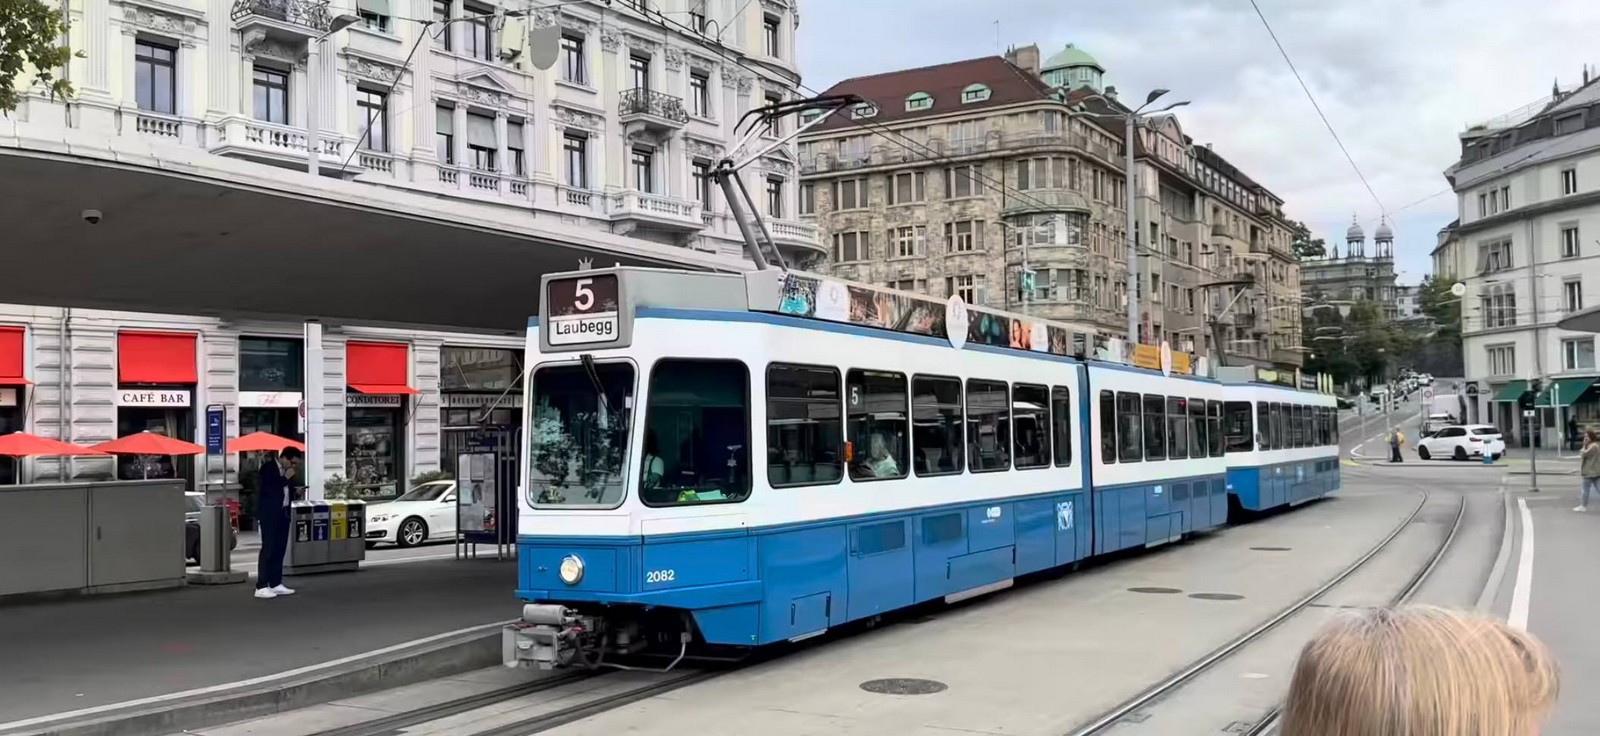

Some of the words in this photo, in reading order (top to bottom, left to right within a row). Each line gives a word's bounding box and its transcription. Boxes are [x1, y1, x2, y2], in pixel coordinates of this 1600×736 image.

[574, 278, 595, 311] 5
[556, 320, 613, 336] Laubegg
[122, 391, 155, 403] CAFÉ
[160, 393, 184, 403] BAR
[346, 395, 400, 404] CONDITOREI
[851, 386, 859, 405] 5
[646, 569, 675, 583] 2082
